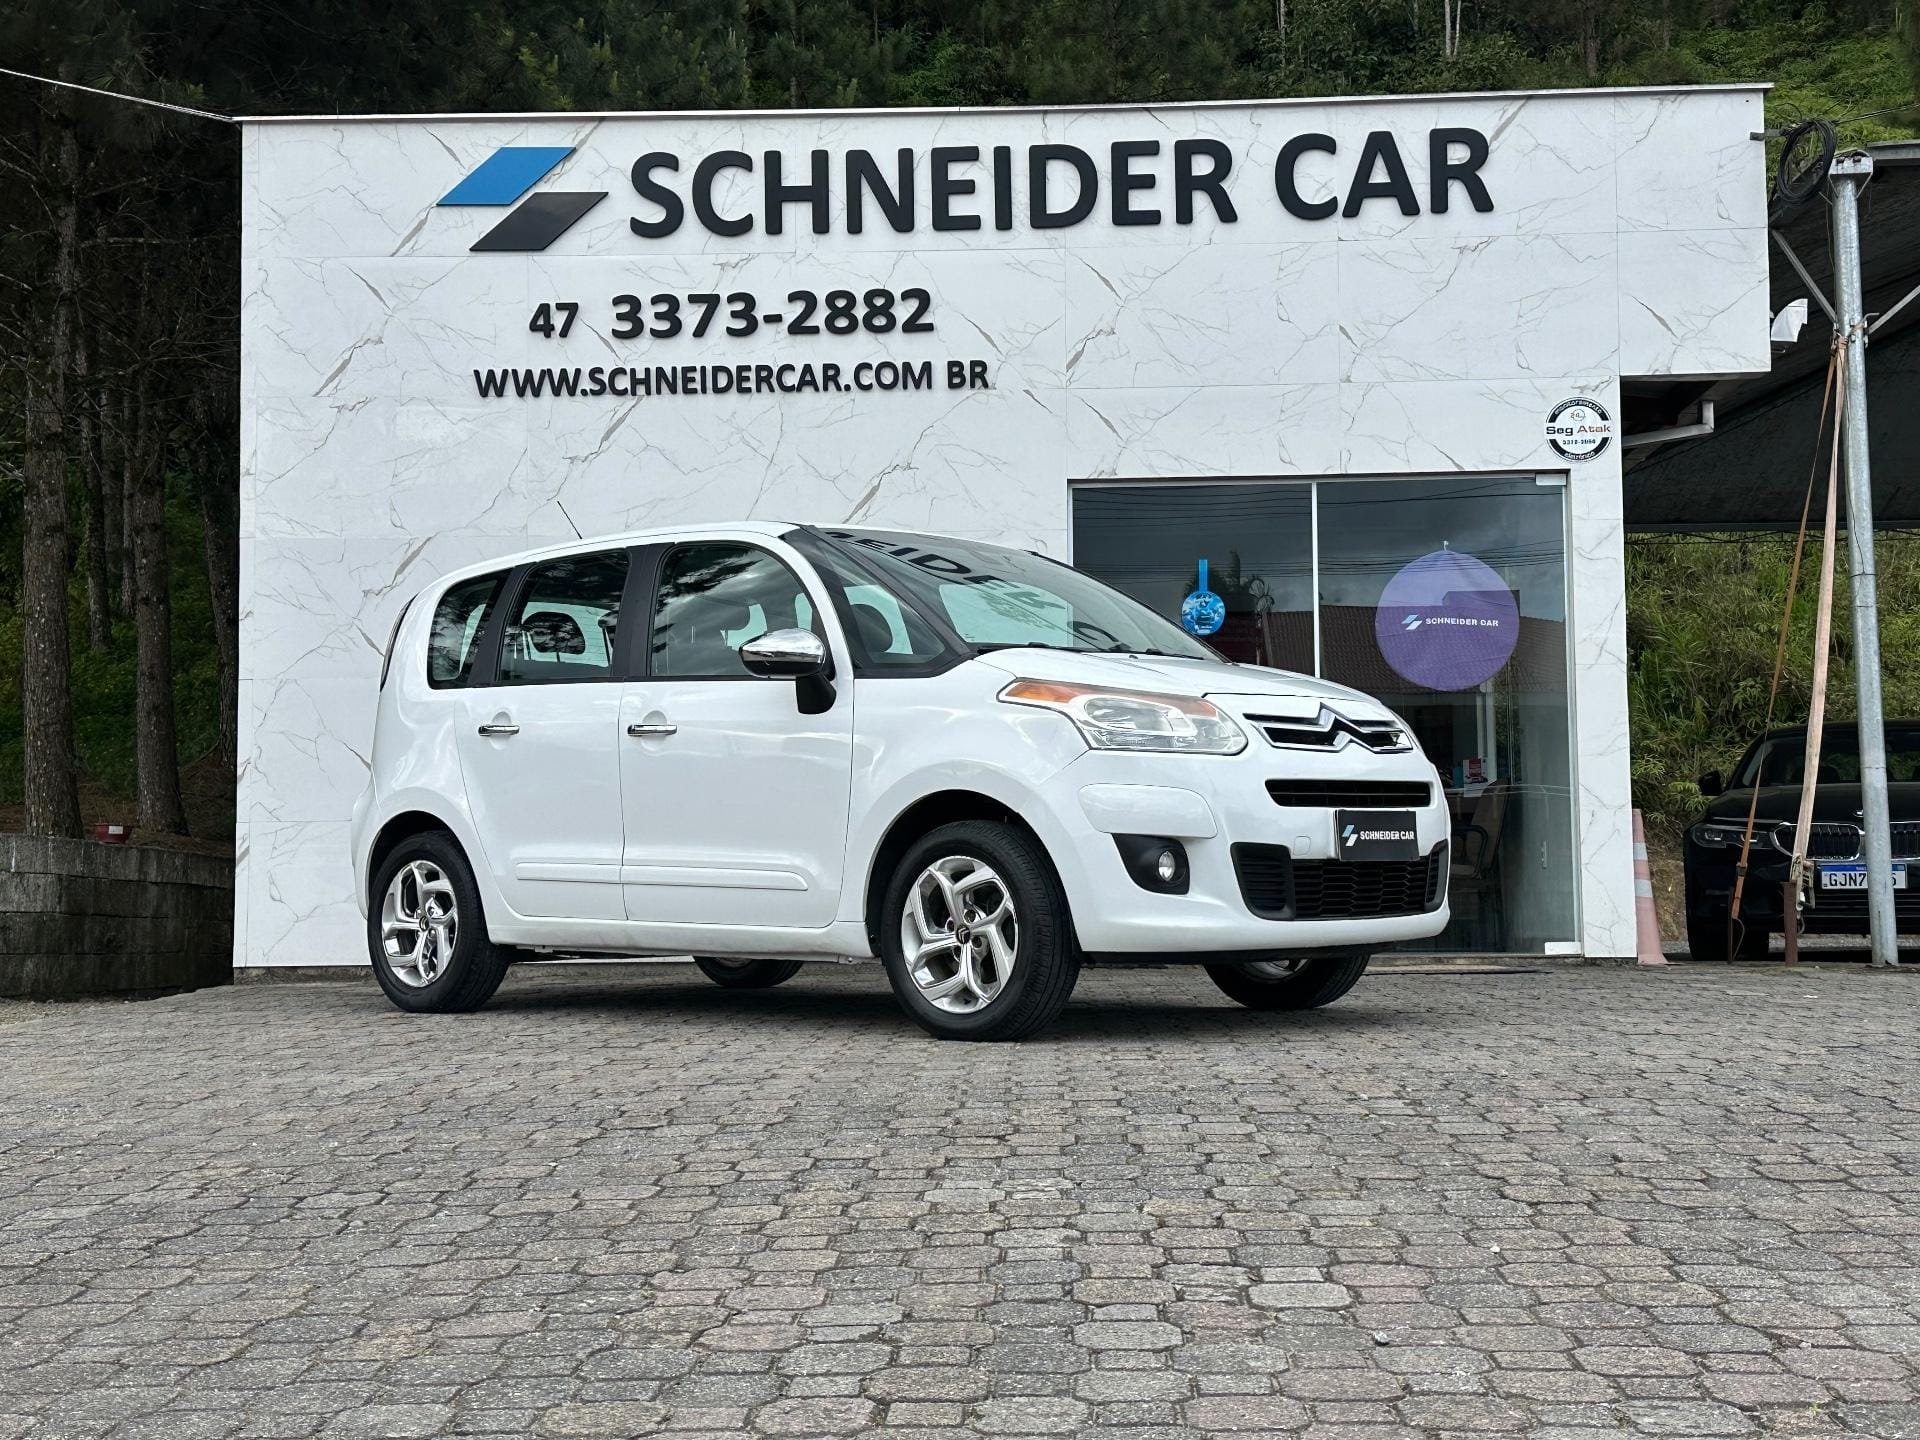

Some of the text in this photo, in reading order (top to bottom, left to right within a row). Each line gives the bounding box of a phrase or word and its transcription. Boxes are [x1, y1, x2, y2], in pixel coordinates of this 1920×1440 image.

[629, 127, 1495, 240] SCHNEIDER CAR
[528, 287, 935, 341] 47 3373-2882
[473, 358, 991, 399] WWW.SCHNEIDERCAR.COM BR
[1546, 425, 1611, 436] Seg Atak
[1425, 617, 1499, 627] SCHNEIDER CAR
[1360, 830, 1415, 840] SCHNEIDER CAR
